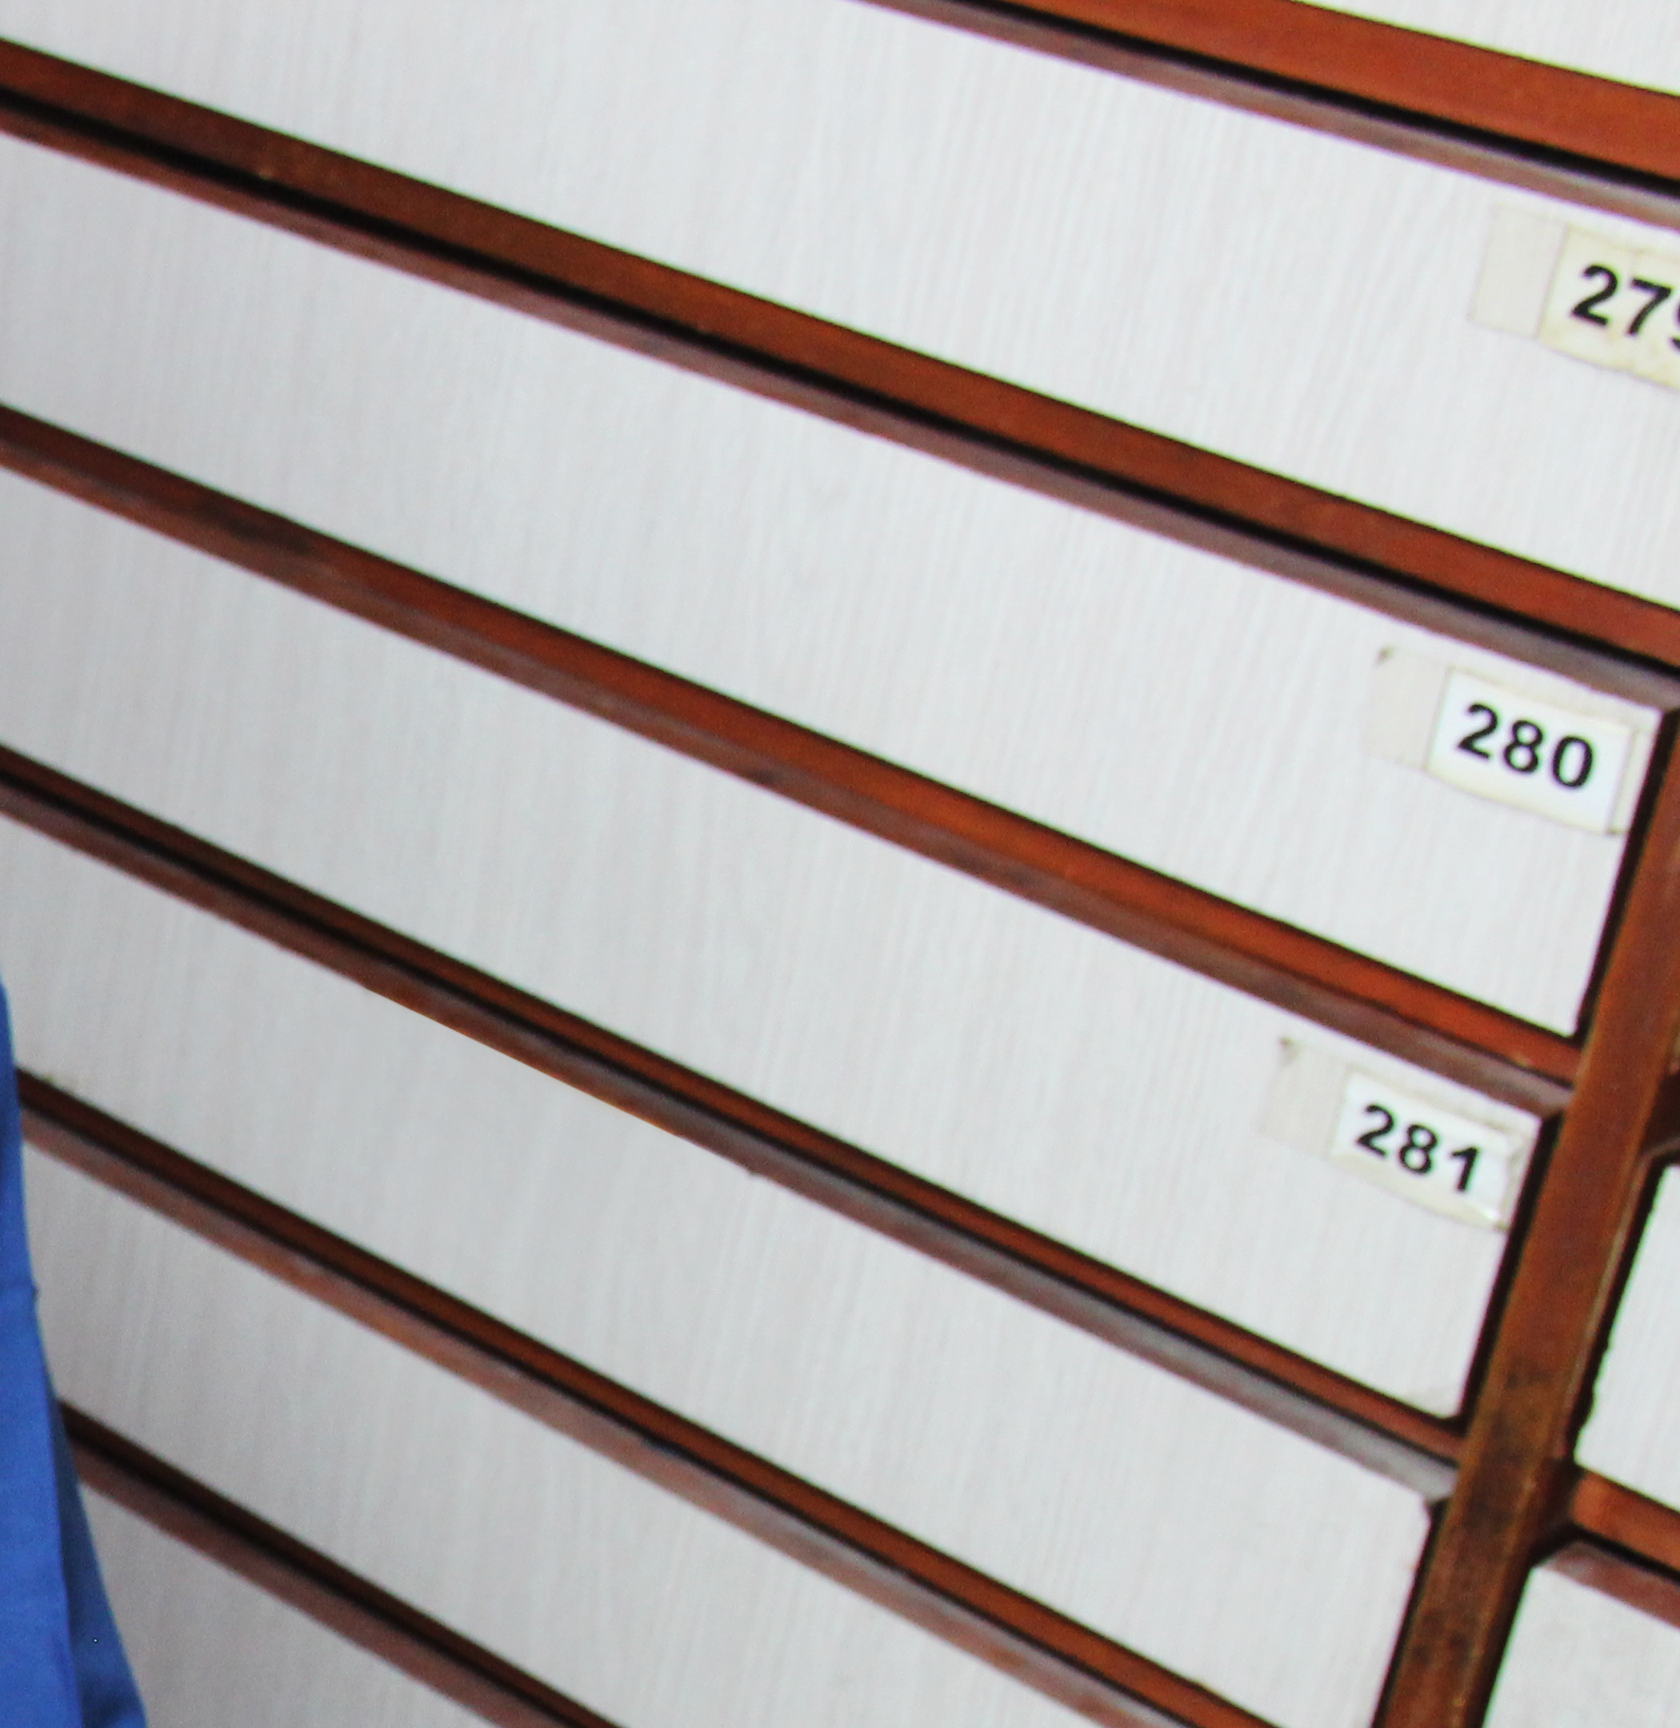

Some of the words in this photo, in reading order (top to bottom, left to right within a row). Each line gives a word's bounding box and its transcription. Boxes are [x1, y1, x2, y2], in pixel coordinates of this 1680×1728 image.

[1571, 265, 1680, 350] 27
[1458, 703, 1593, 789] 280
[1356, 1104, 1479, 1192] 281
